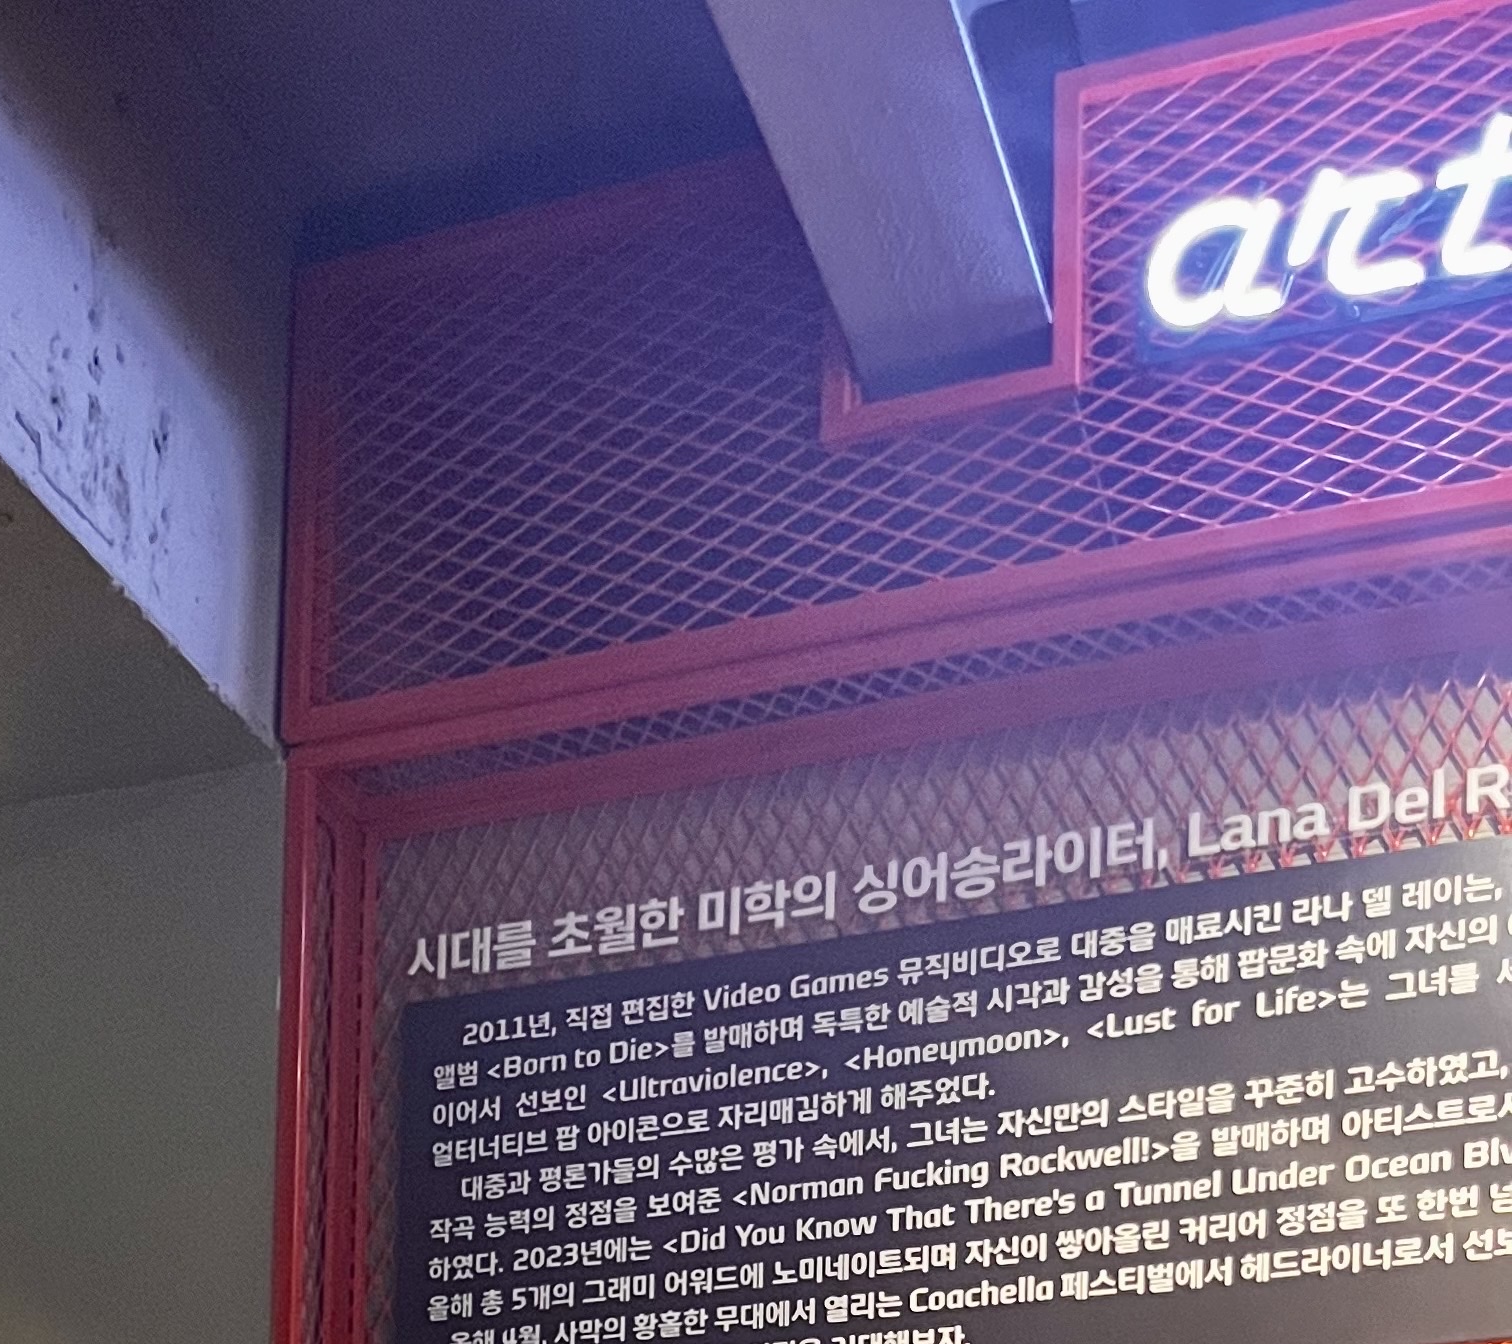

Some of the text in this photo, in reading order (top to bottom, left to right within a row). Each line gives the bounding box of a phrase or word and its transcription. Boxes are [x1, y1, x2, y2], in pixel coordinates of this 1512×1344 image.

[408, 763, 1510, 979] 시대를 초월한 미학의 싱어송라이터, Lana Del R
[433, 1059, 479, 1091] 앨범
[486, 1053, 567, 1079] <Born
[574, 1047, 602, 1069] to
[609, 1030, 696, 1064] Die>를
[703, 1014, 804, 1054] 발매하며
[810, 1002, 893, 1038] 독특한
[897, 989, 978, 1026] 예술적
[986, 976, 1071, 1013] 시각과
[1078, 962, 1164, 1002] 감성을
[1170, 952, 1231, 990] 통해
[1237, 938, 1331, 980] 팝문화
[1335, 928, 1397, 965] 속에
[1404, 913, 1499, 955] 자신의
[462, 873, 1502, 1046] 2011년, 직접 편집한 Video Games 뮤직비디오로 대중을 매료시킨 라나 델 레이는,
[432, 1095, 501, 1128] 이어서
[515, 1083, 587, 1118] 선보인
[602, 1061, 828, 1103] <Ultraviolence>,
[844, 1028, 1069, 1071] <Honeymoon>,
[1086, 1006, 1178, 1039] <Lust
[1191, 998, 1242, 1027] for
[1255, 978, 1371, 1018] Life>는
[1384, 962, 1480, 1001] 그녀를
[432, 1071, 996, 1168] 얼터너티브 팝 아이콘으로 자리매김하게 해주었다.
[429, 1113, 1331, 1244] 작곡 능력의 정점을 보여준 <Norman Fucking Rockwell!>을 발매하며
[460, 1049, 1509, 1202] 대중과 평론가들의 수많은 평가 속에서, 그녀는 자신만의 스타일을 꾸준히 고수하였고,
[428, 1149, 1455, 1282] 하였다. 2023년에는 <Did You Know That There's a Tunnel Under Ocean
[632, 1307, 709, 1341] 황홀한
[713, 1297, 816, 1333] 무대에서
[823, 1286, 904, 1324] 열리는
[909, 1274, 1055, 1313] Coachella
[1059, 1253, 1236, 1301] 페스티벌에서
[1240, 1231, 1455, 1283] 헤드라이너로서
